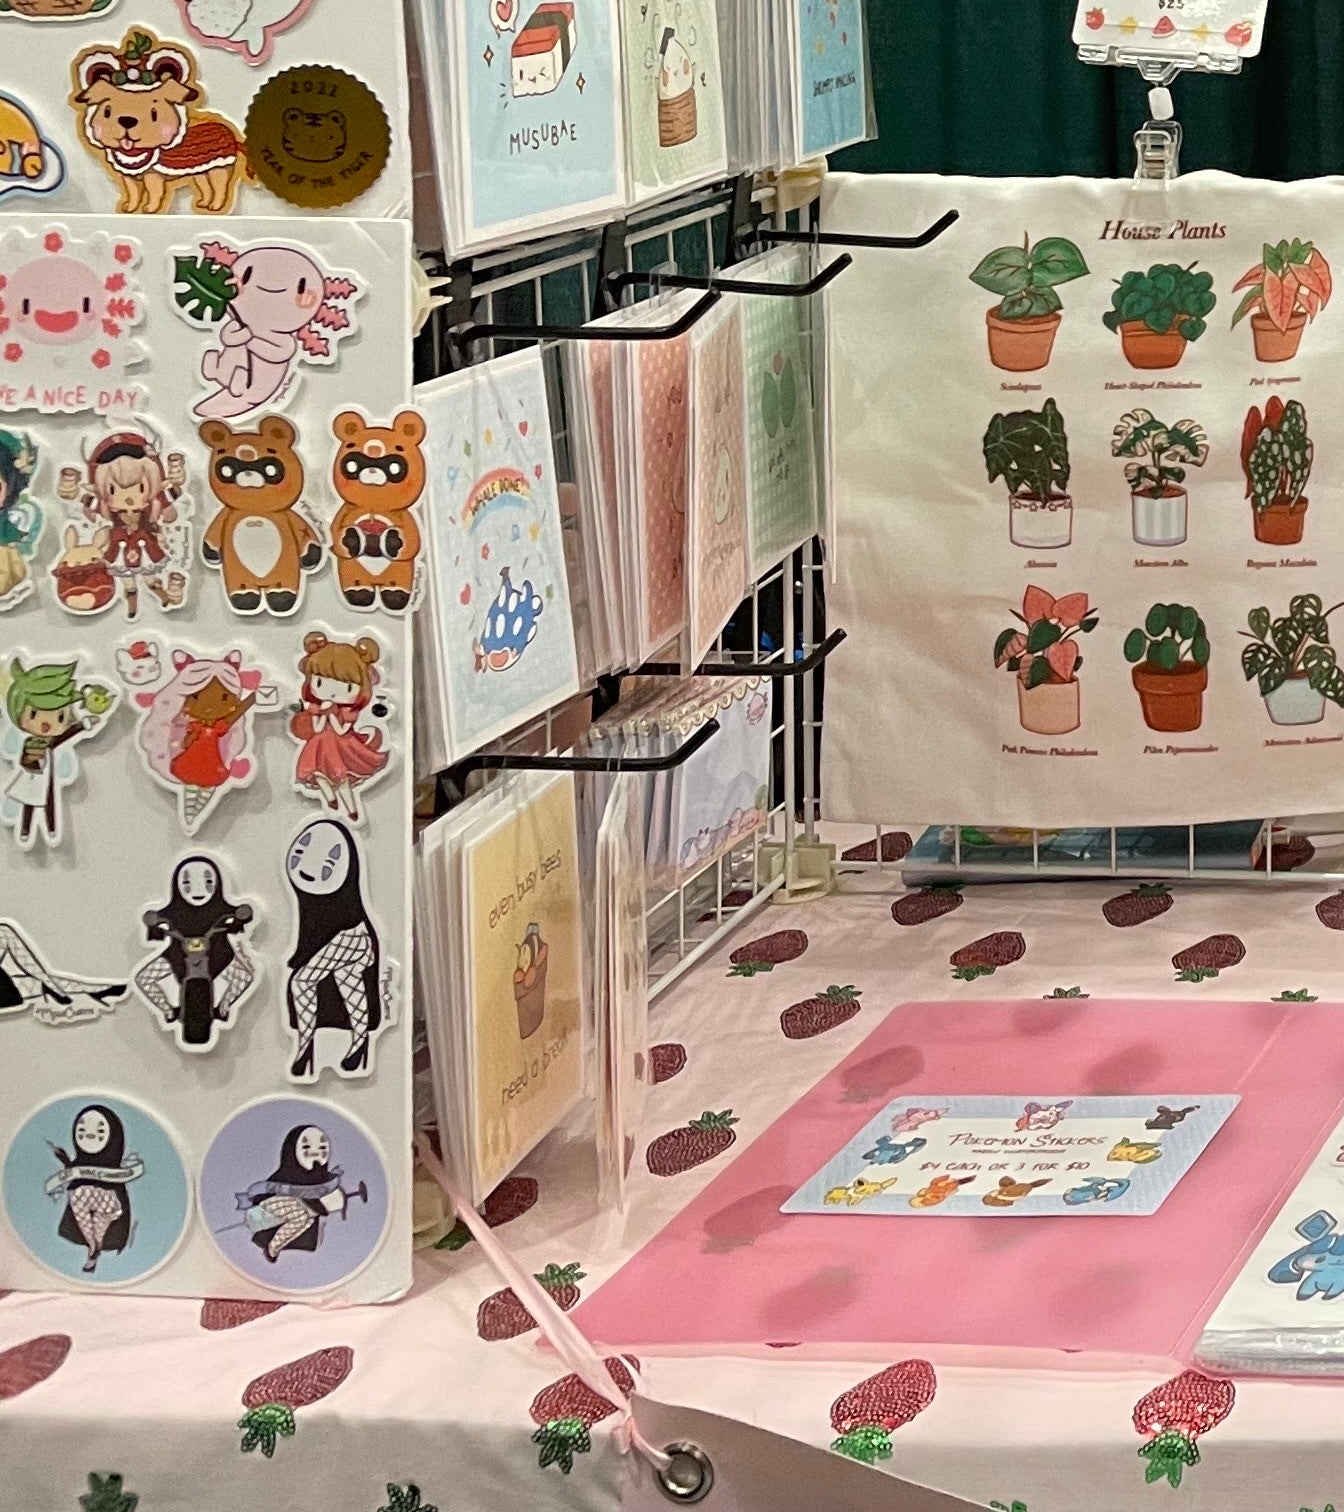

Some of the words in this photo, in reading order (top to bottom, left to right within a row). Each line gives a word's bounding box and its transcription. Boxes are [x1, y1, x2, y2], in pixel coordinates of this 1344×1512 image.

[509, 119, 578, 155] MUSUBAE
[1099, 220, 1161, 241] House
[1169, 220, 1227, 241] Plants
[43, 385, 87, 407] NICE
[98, 388, 137, 408] DAY
[489, 892, 514, 930] even
[516, 870, 539, 904] busy
[540, 849, 563, 884] bees
[500, 1059, 529, 1107] need
